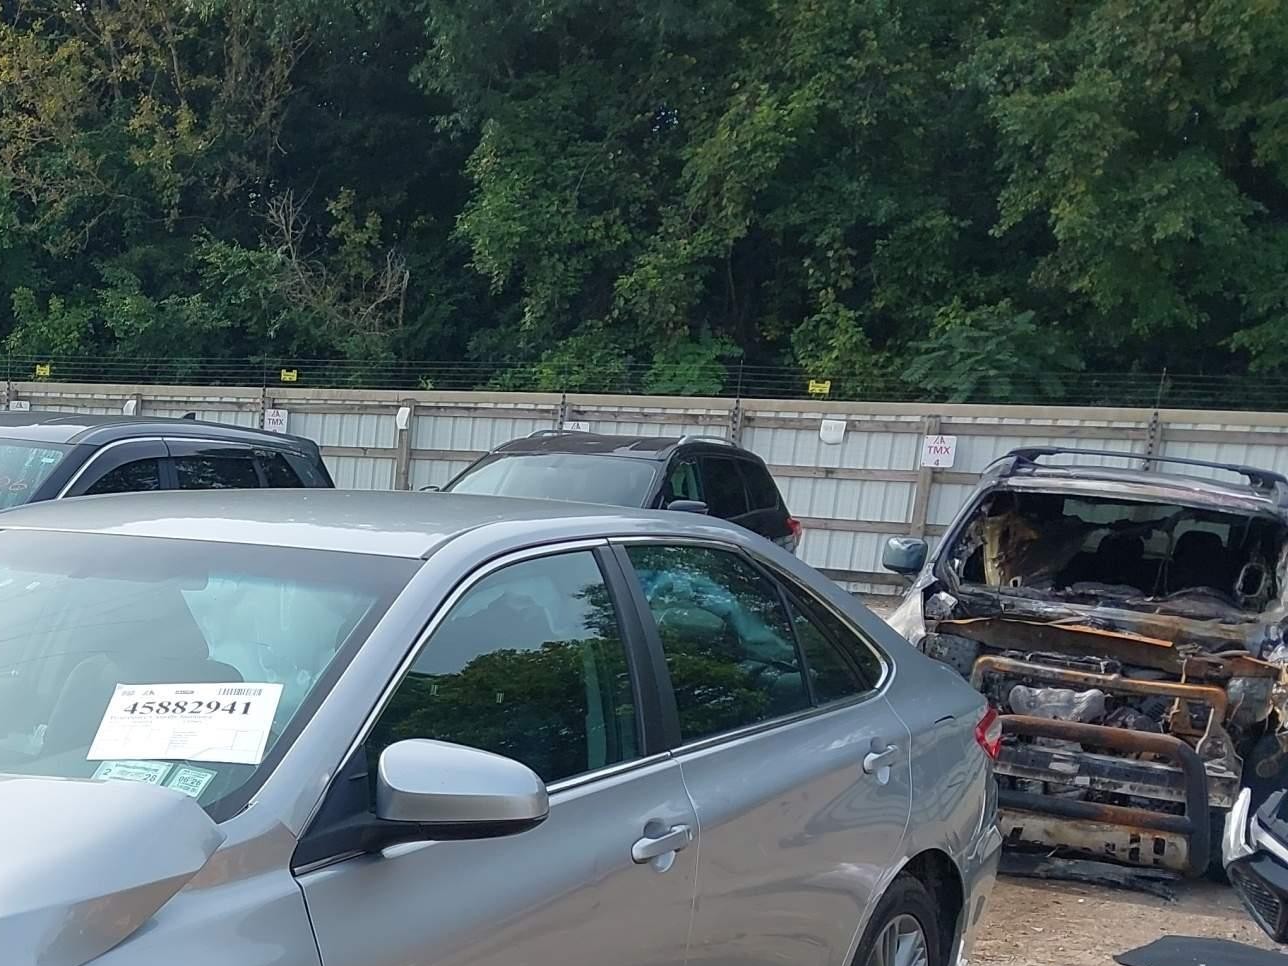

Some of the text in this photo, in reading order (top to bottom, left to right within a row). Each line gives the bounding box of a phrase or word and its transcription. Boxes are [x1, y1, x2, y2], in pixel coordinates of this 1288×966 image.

[267, 418, 284, 426] TMX
[927, 446, 951, 455] TMX
[123, 700, 252, 715] 45882941
